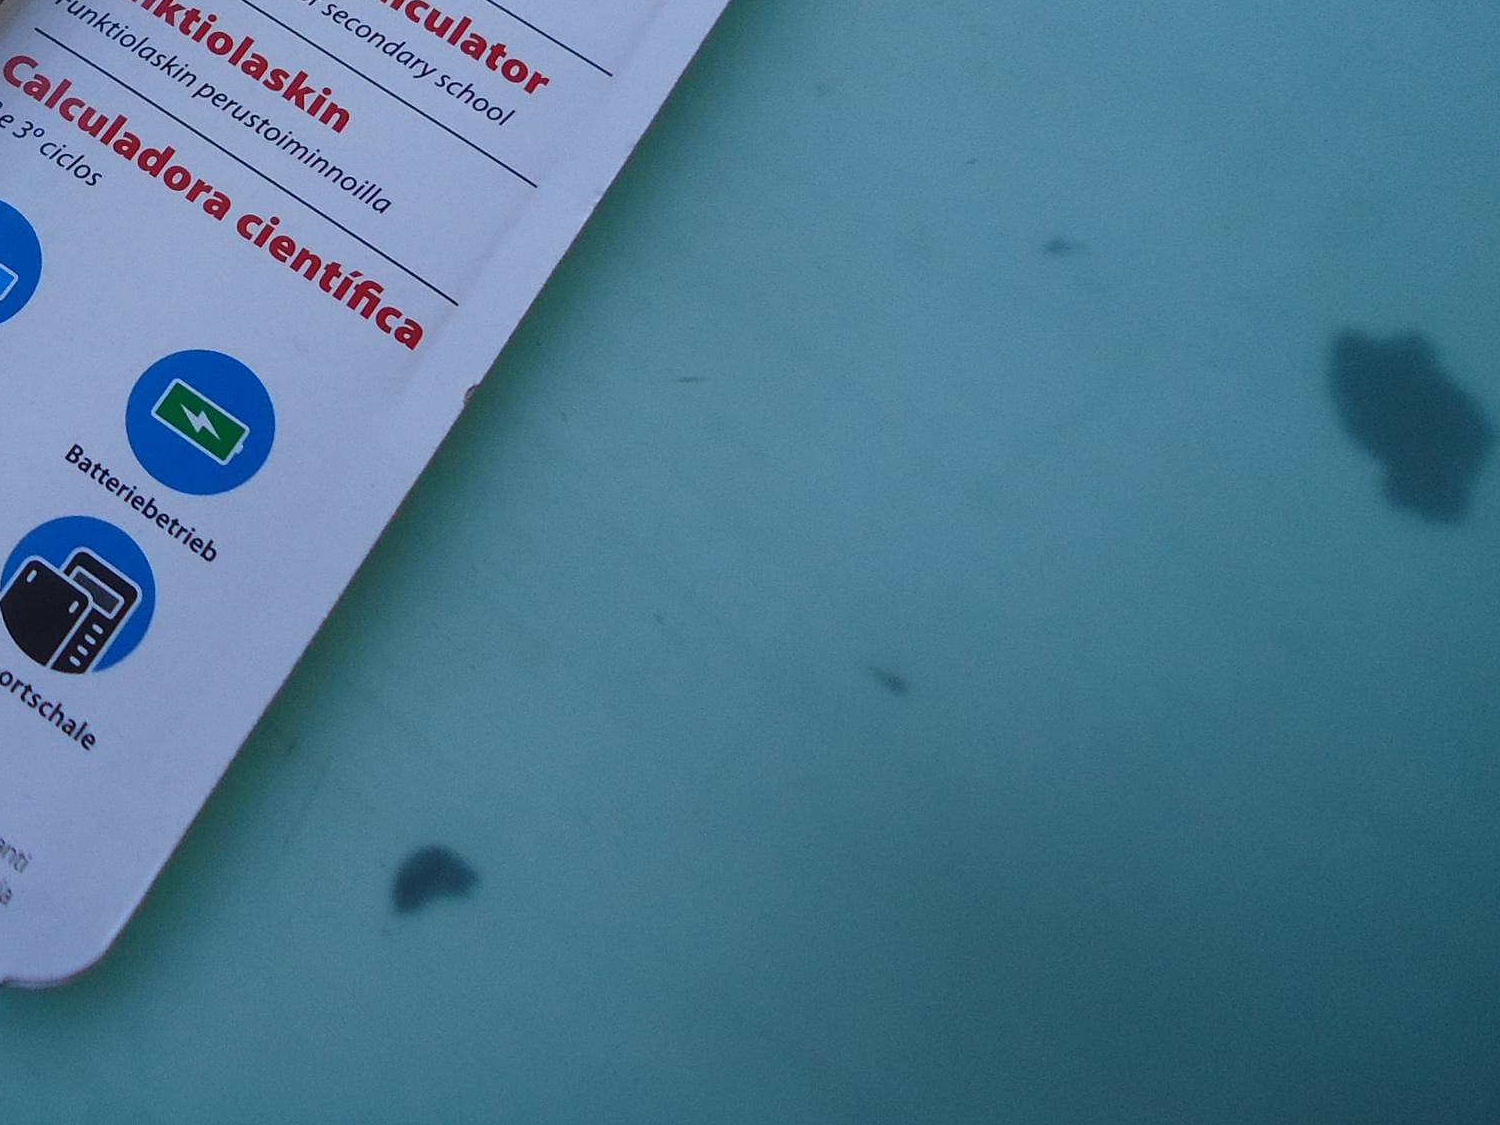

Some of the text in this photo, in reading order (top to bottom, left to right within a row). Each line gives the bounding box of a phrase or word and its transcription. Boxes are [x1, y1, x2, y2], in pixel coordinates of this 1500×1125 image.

[322, 2, 436, 79] secondary
[434, 71, 516, 126] school
[2, 56, 425, 351] Calculadora científica
[39, 135, 103, 187] ciclos
[192, 83, 392, 215] perustoiminnoilla
[64, 444, 219, 564] Batteriebetrieb
